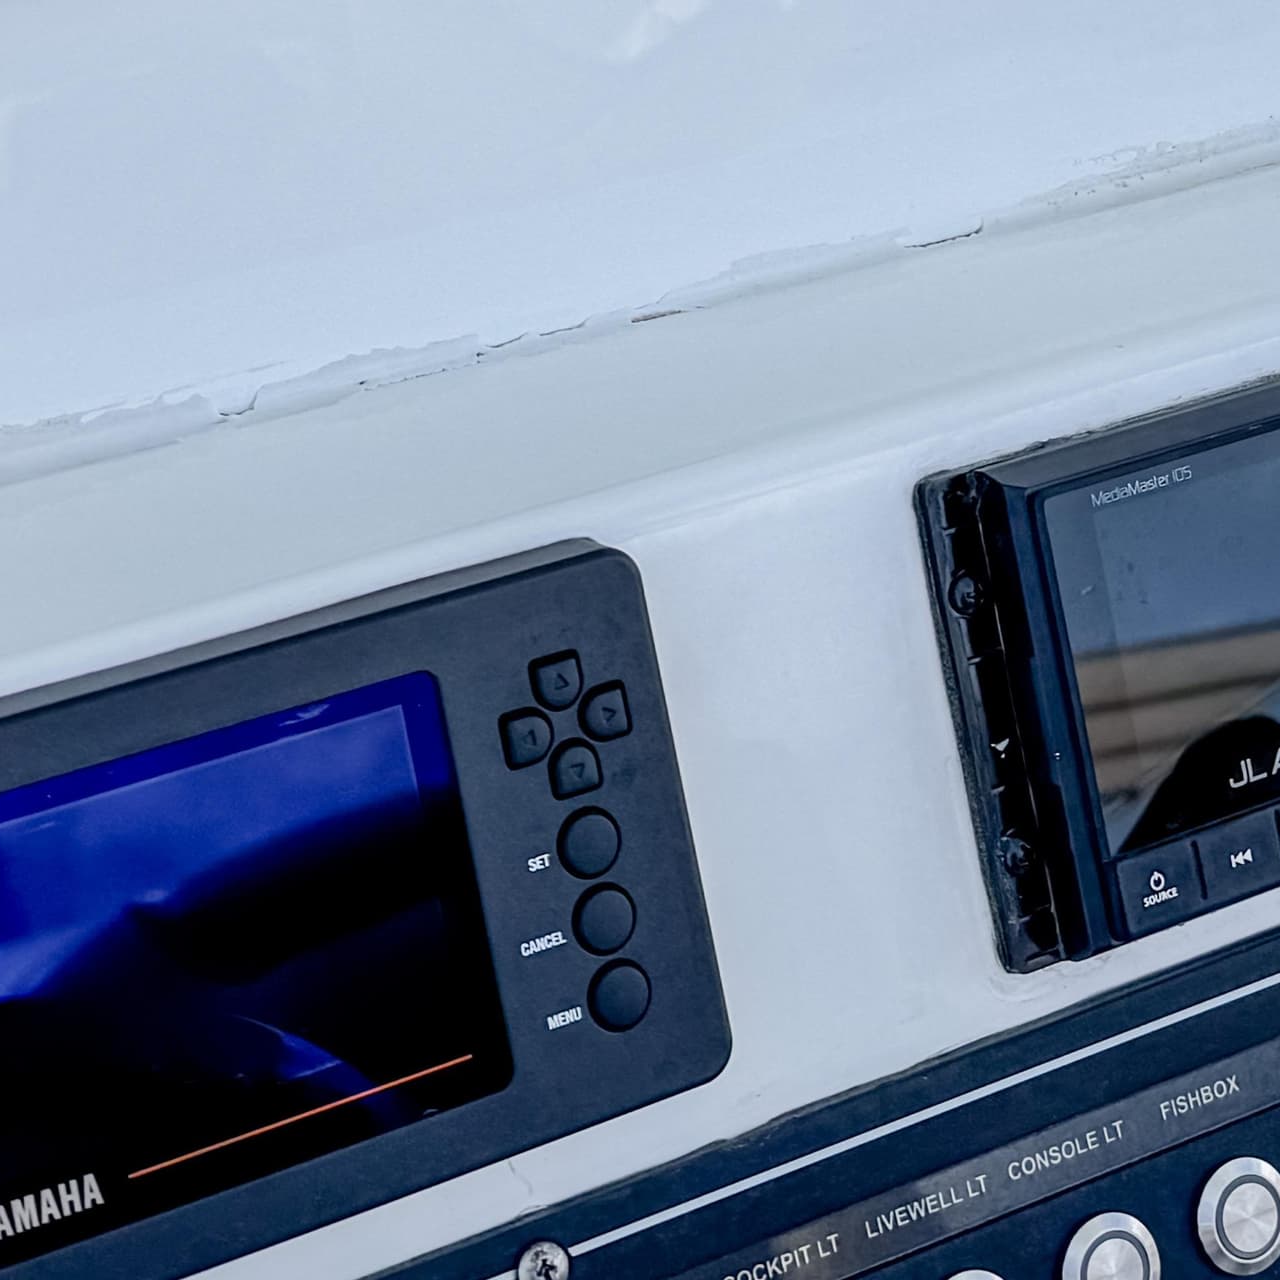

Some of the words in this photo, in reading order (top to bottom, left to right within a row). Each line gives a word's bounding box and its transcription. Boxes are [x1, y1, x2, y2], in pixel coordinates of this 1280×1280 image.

[1229, 758, 1268, 788] JL
[527, 853, 551, 873] SET
[1143, 887, 1179, 908] SOURCE
[520, 931, 568, 958] CANCEL
[547, 1006, 582, 1031] MENU
[1159, 1074, 1240, 1120] FISHBOX
[1007, 1130, 1100, 1181] CONSOLE
[1103, 1120, 1124, 1143] LT
[865, 1187, 964, 1239] LIVEWELL
[966, 1174, 988, 1197] LT
[723, 1243, 811, 1280] OCKPIT
[817, 1233, 839, 1258] LT
